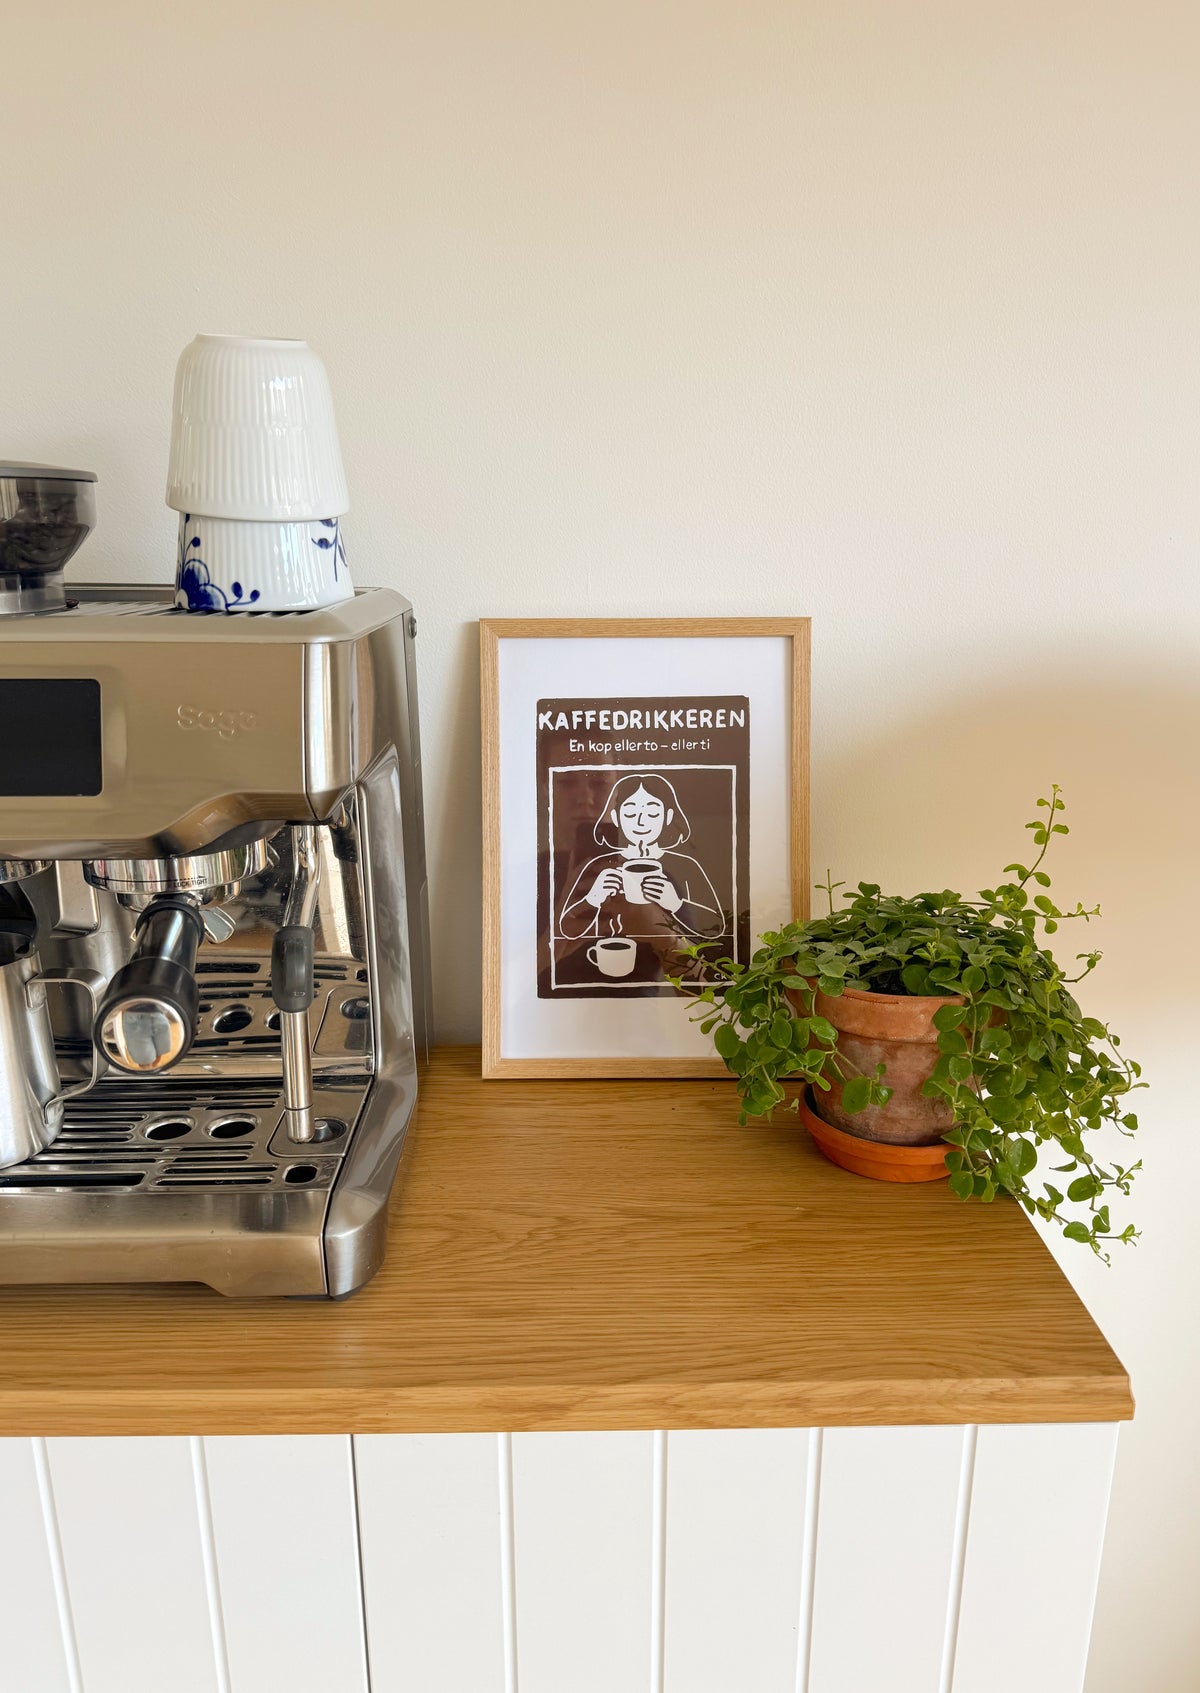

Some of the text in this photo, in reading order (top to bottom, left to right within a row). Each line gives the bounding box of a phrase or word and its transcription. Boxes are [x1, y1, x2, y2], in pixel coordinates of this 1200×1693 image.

[538, 709, 745, 731] KAFFEDRIKKEREN
[569, 738, 585, 752] En
[588, 740, 612, 755] kop
